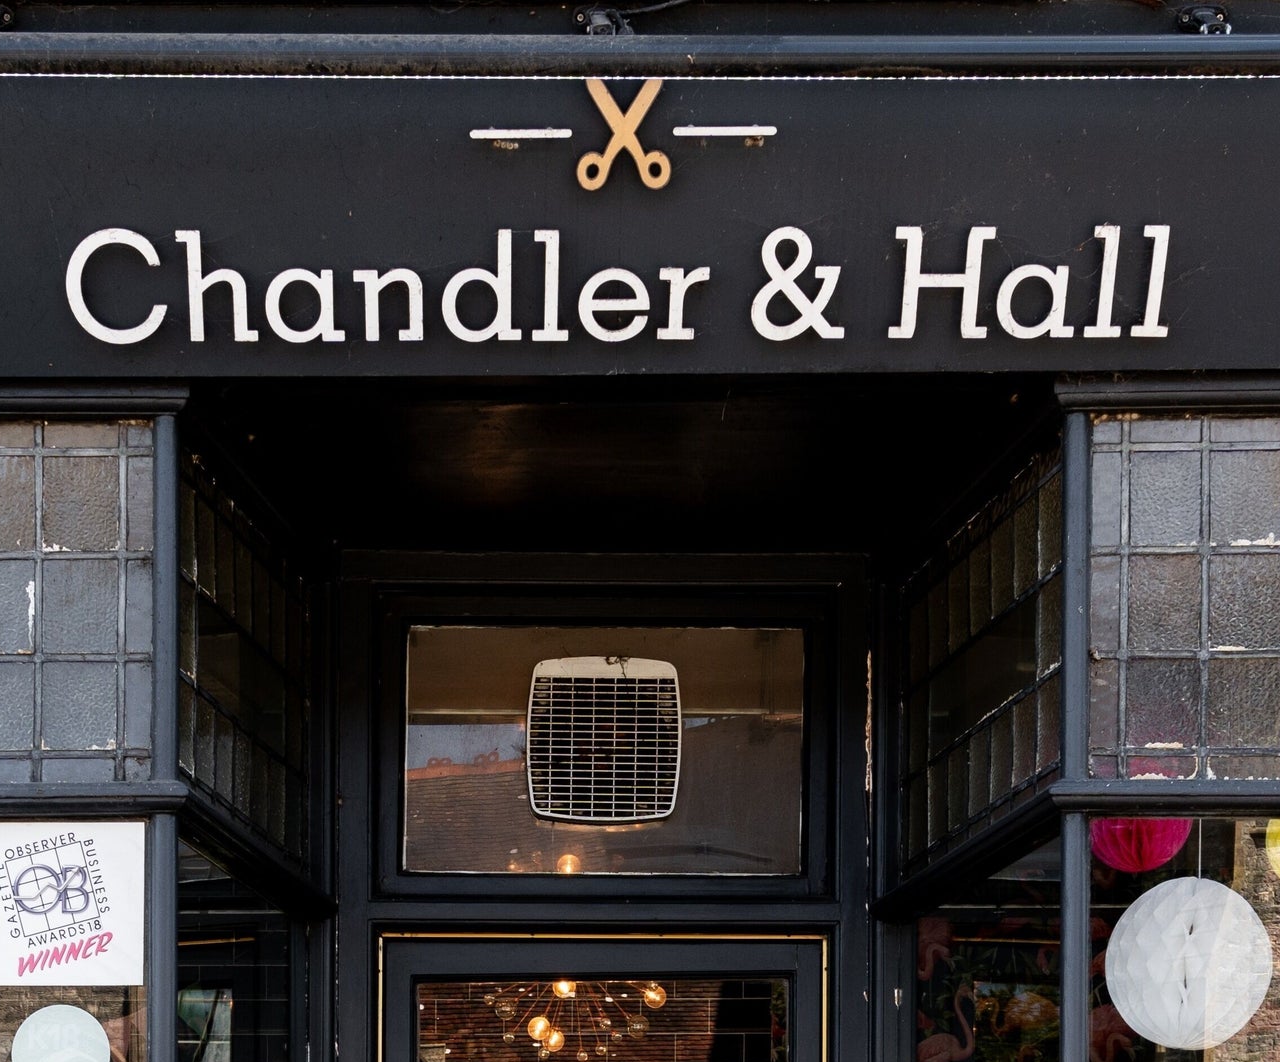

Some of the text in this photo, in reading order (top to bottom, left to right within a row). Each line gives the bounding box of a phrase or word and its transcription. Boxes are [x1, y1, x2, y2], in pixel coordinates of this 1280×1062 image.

[65, 223, 1172, 346] Chandler & Hall
[4, 832, 76, 860] OBSERVER
[83, 838, 110, 913] BUSINESS
[17, 931, 114, 977] WINNER
